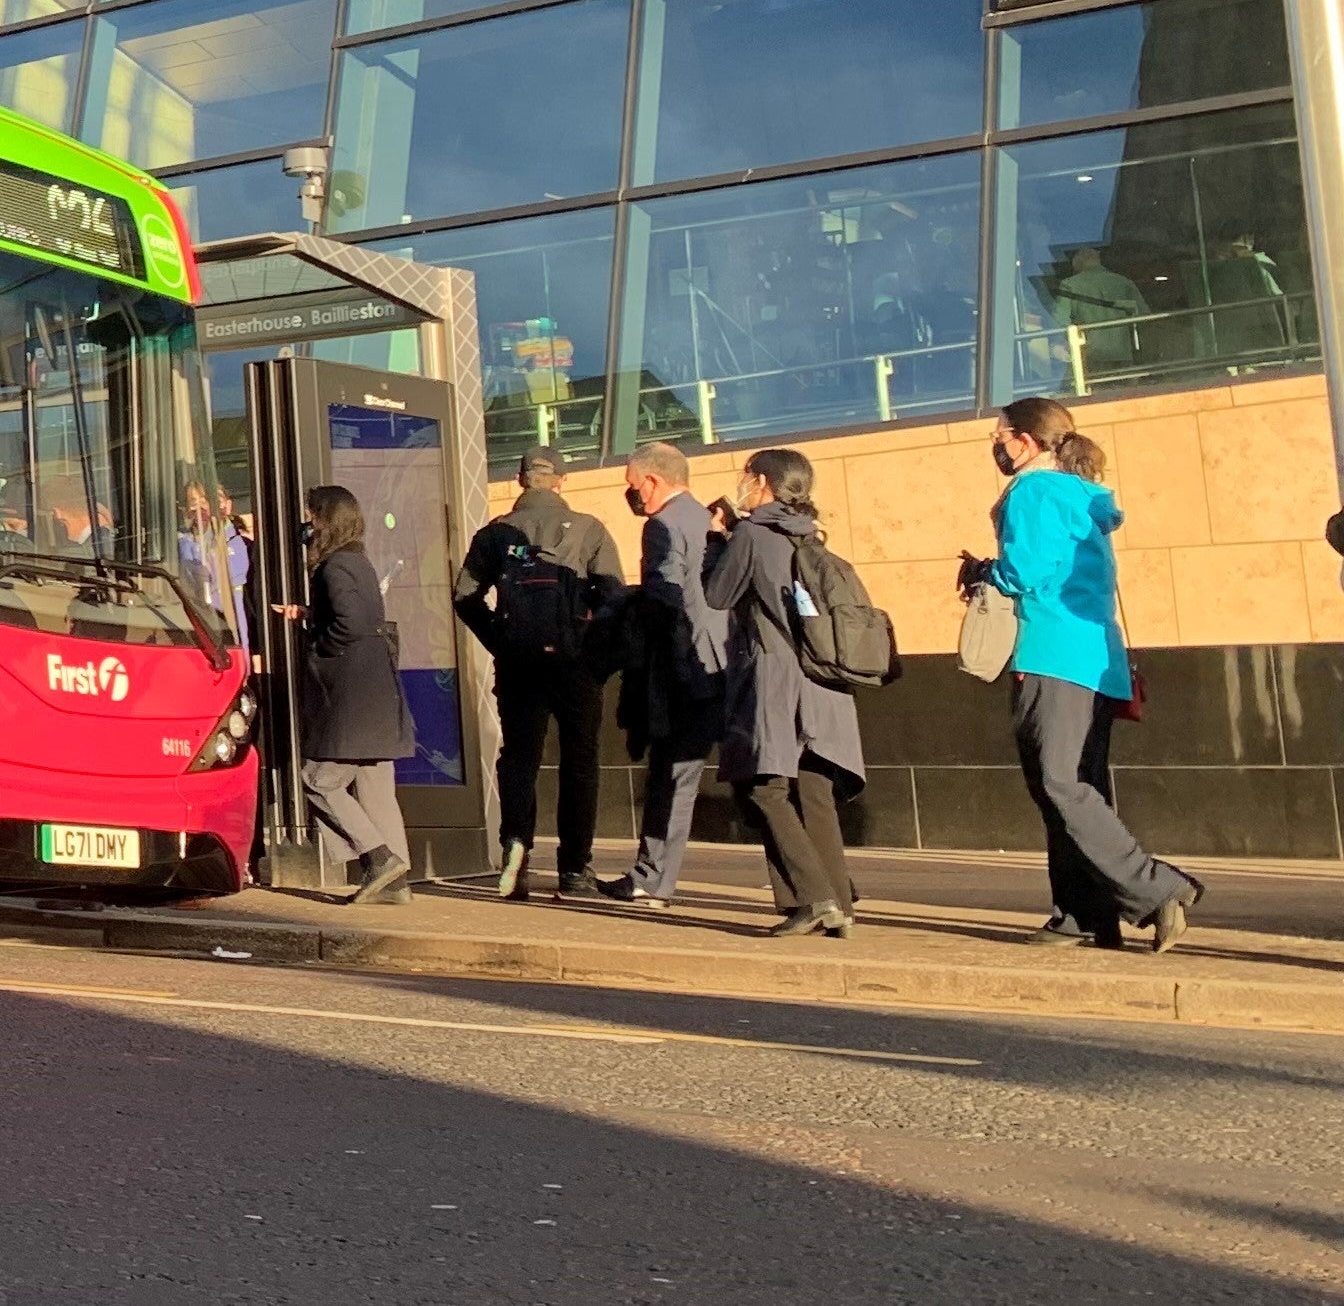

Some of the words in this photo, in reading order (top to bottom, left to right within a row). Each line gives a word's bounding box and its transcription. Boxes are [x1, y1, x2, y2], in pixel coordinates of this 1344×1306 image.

[205, 314, 307, 338] Easterhouse,
[311, 301, 396, 325] Baillieston
[47, 654, 99, 695] First
[162, 737, 192, 758] 64116
[53, 829, 92, 858] LG71
[96, 833, 127, 861] DMY
